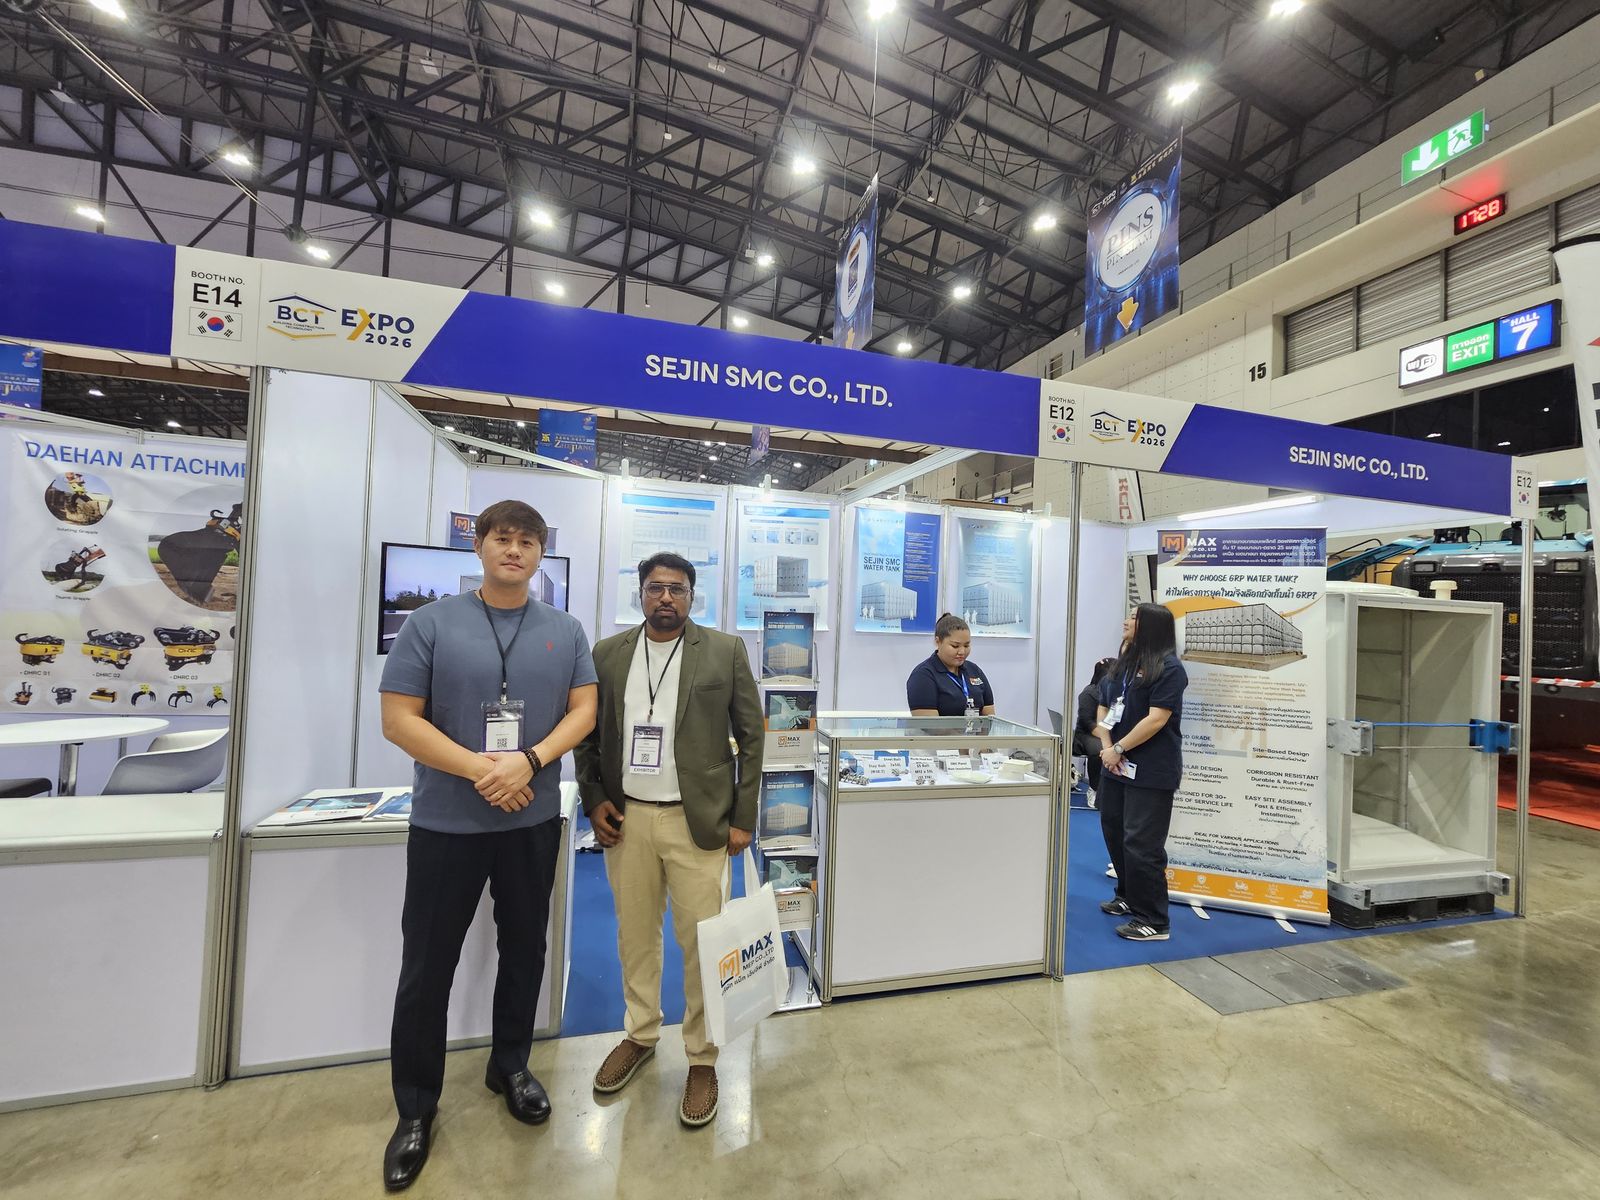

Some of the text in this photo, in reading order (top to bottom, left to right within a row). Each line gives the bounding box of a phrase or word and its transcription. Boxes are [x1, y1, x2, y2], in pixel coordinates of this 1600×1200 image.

[1107, 205, 1154, 255] PINS
[191, 271, 245, 285] BOOTH NO.
[192, 282, 242, 307] E14
[277, 304, 324, 325] BCT
[1510, 312, 1540, 327] HALL
[341, 308, 415, 342] EXPO
[365, 333, 412, 348] 2026
[1452, 333, 1489, 350] ทางออก
[1512, 320, 1539, 351] 7
[1452, 342, 1489, 362] EXIT
[1249, 362, 1267, 382] 15
[645, 354, 893, 407] SEJIN SMC CO., LTD.
[0, 384, 38, 396] JIANG
[1048, 396, 1066, 404] BOOTH
[1050, 404, 1074, 421] E12
[1095, 418, 1120, 432] BCT
[1127, 417, 1167, 443] EXPO
[1140, 436, 1165, 447] 2026
[24, 441, 122, 467] DAEHAN
[1289, 445, 1429, 481] SEJIN SMC CO., LTD.
[1517, 475, 1532, 488] E12
[1187, 537, 1217, 547] MAX
[863, 556, 901, 566] SEJIN SMC
[1200, 574, 1227, 582] CHOOSE
[1274, 575, 1299, 583] TANK?
[1252, 747, 1286, 755] Site-Based
[1188, 771, 1229, 780] Configuration
[1246, 768, 1319, 780] CORROSION RESISTANT
[1194, 798, 1219, 806] SERVICE
[1276, 805, 1302, 813] Efficient
[1278, 798, 1312, 807] ASSEMBLY
[1260, 811, 1296, 819] Installation
[741, 931, 773, 963] MAX
[742, 960, 755, 971] MEP
